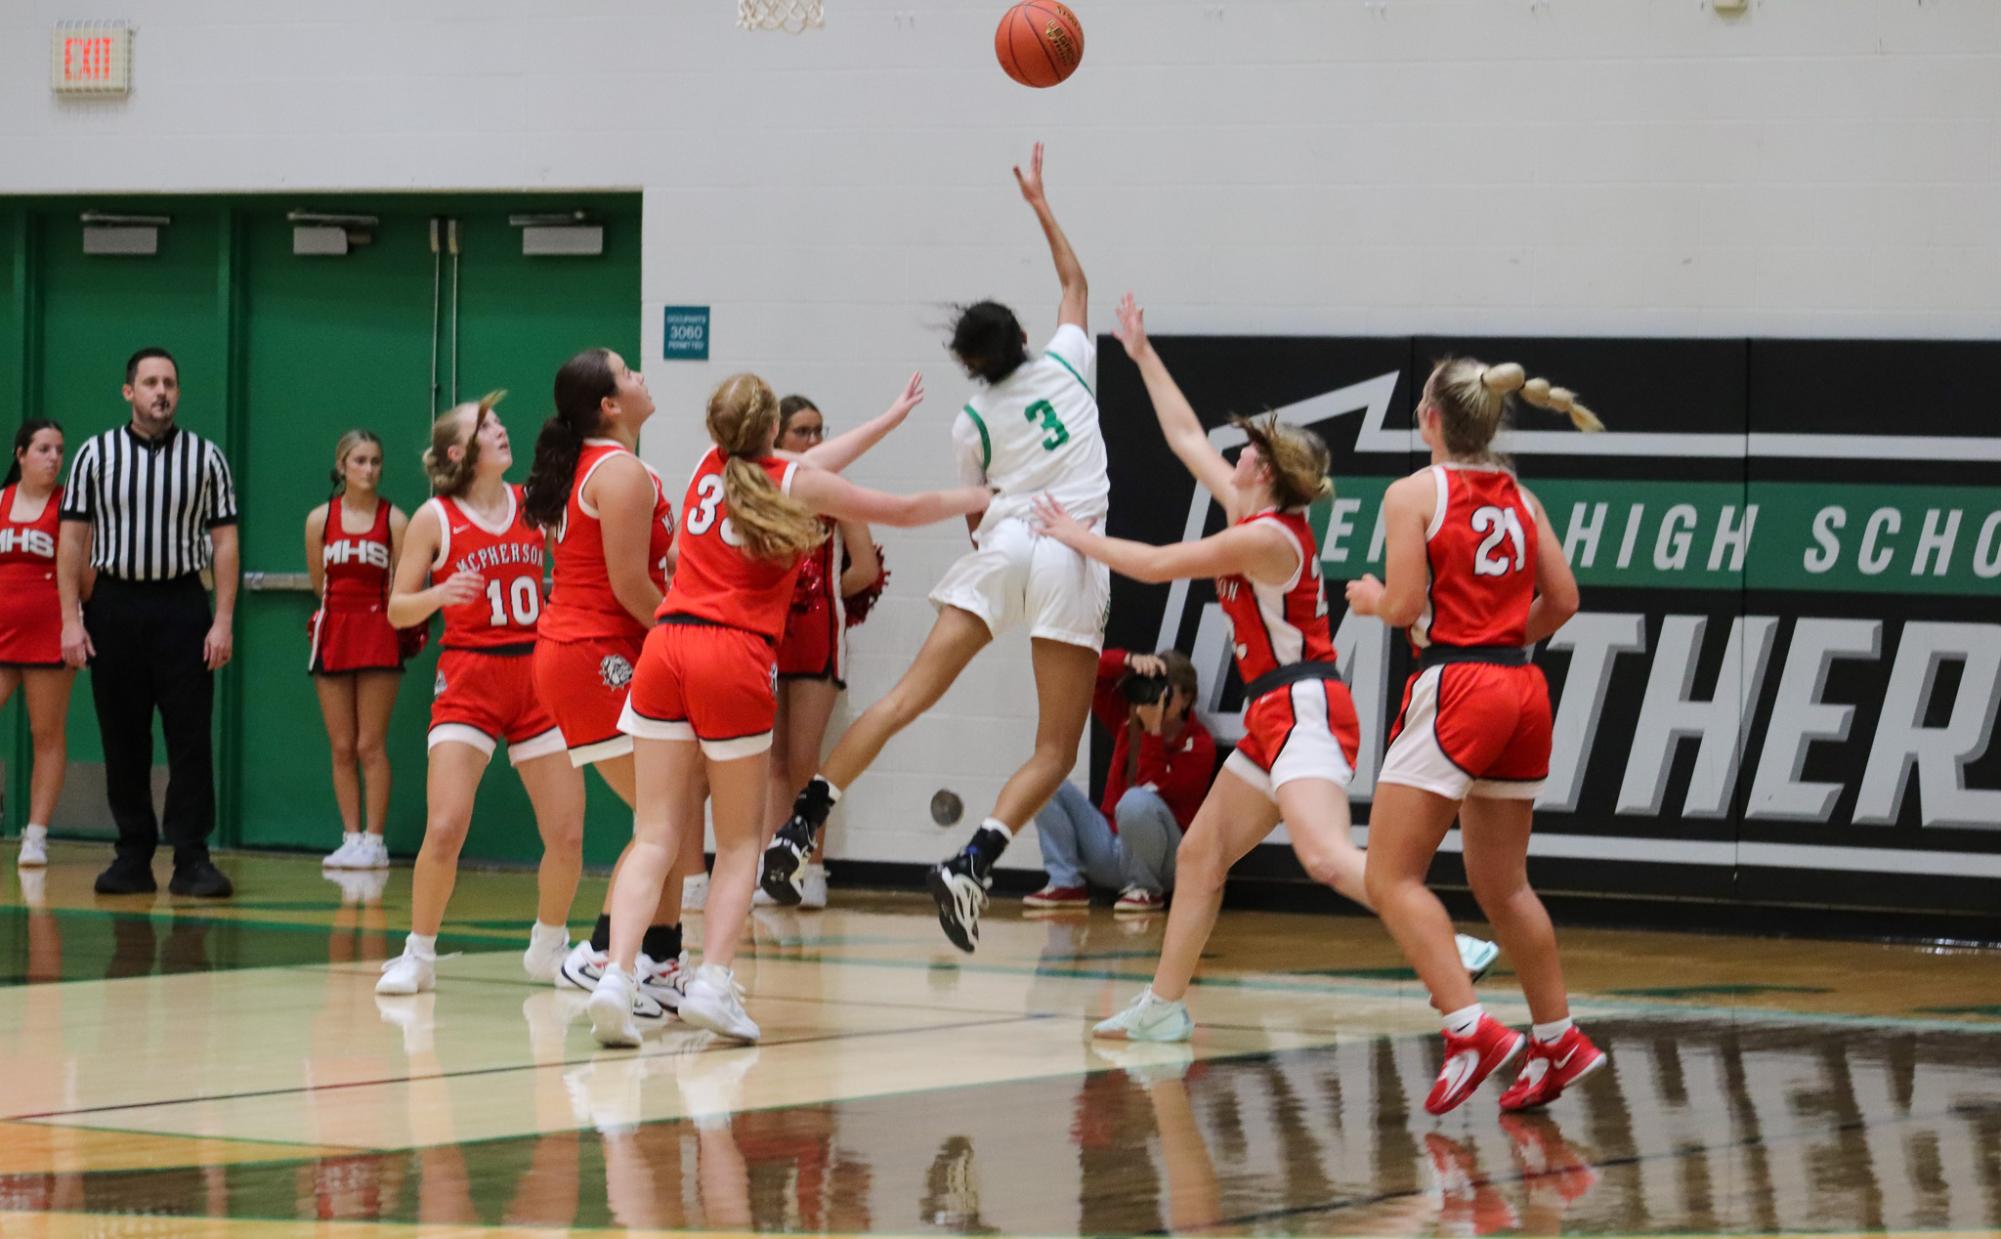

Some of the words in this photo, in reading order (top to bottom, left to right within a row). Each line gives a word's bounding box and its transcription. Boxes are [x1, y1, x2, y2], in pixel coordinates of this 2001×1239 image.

[64, 37, 112, 81] EXIT
[1024, 399, 1070, 451] 3
[323, 538, 388, 569] MHS
[1563, 502, 1759, 572] HIGH
[487, 575, 540, 626] 10
